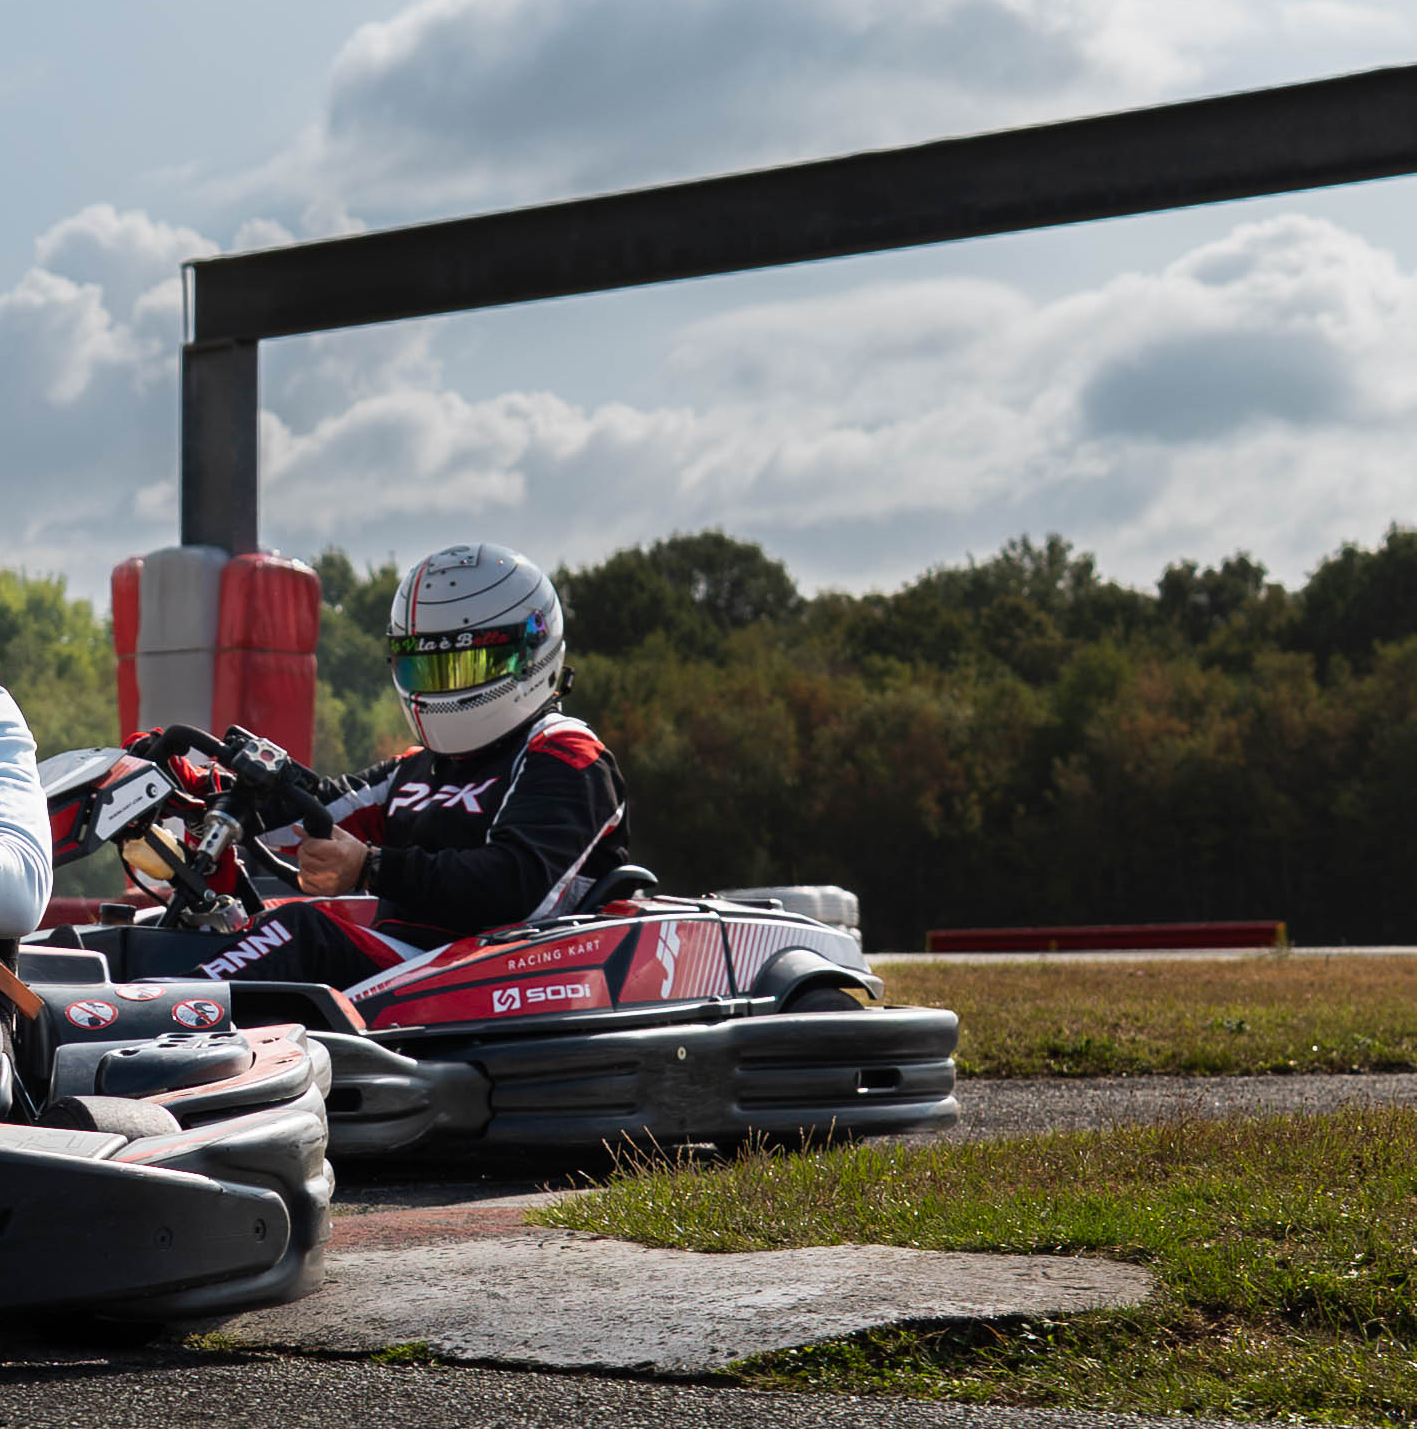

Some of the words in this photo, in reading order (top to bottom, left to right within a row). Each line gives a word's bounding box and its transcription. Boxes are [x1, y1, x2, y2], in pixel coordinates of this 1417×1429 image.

[455, 630, 511, 648] Bella
[508, 948, 562, 970] RACING
[568, 940, 601, 956] KART
